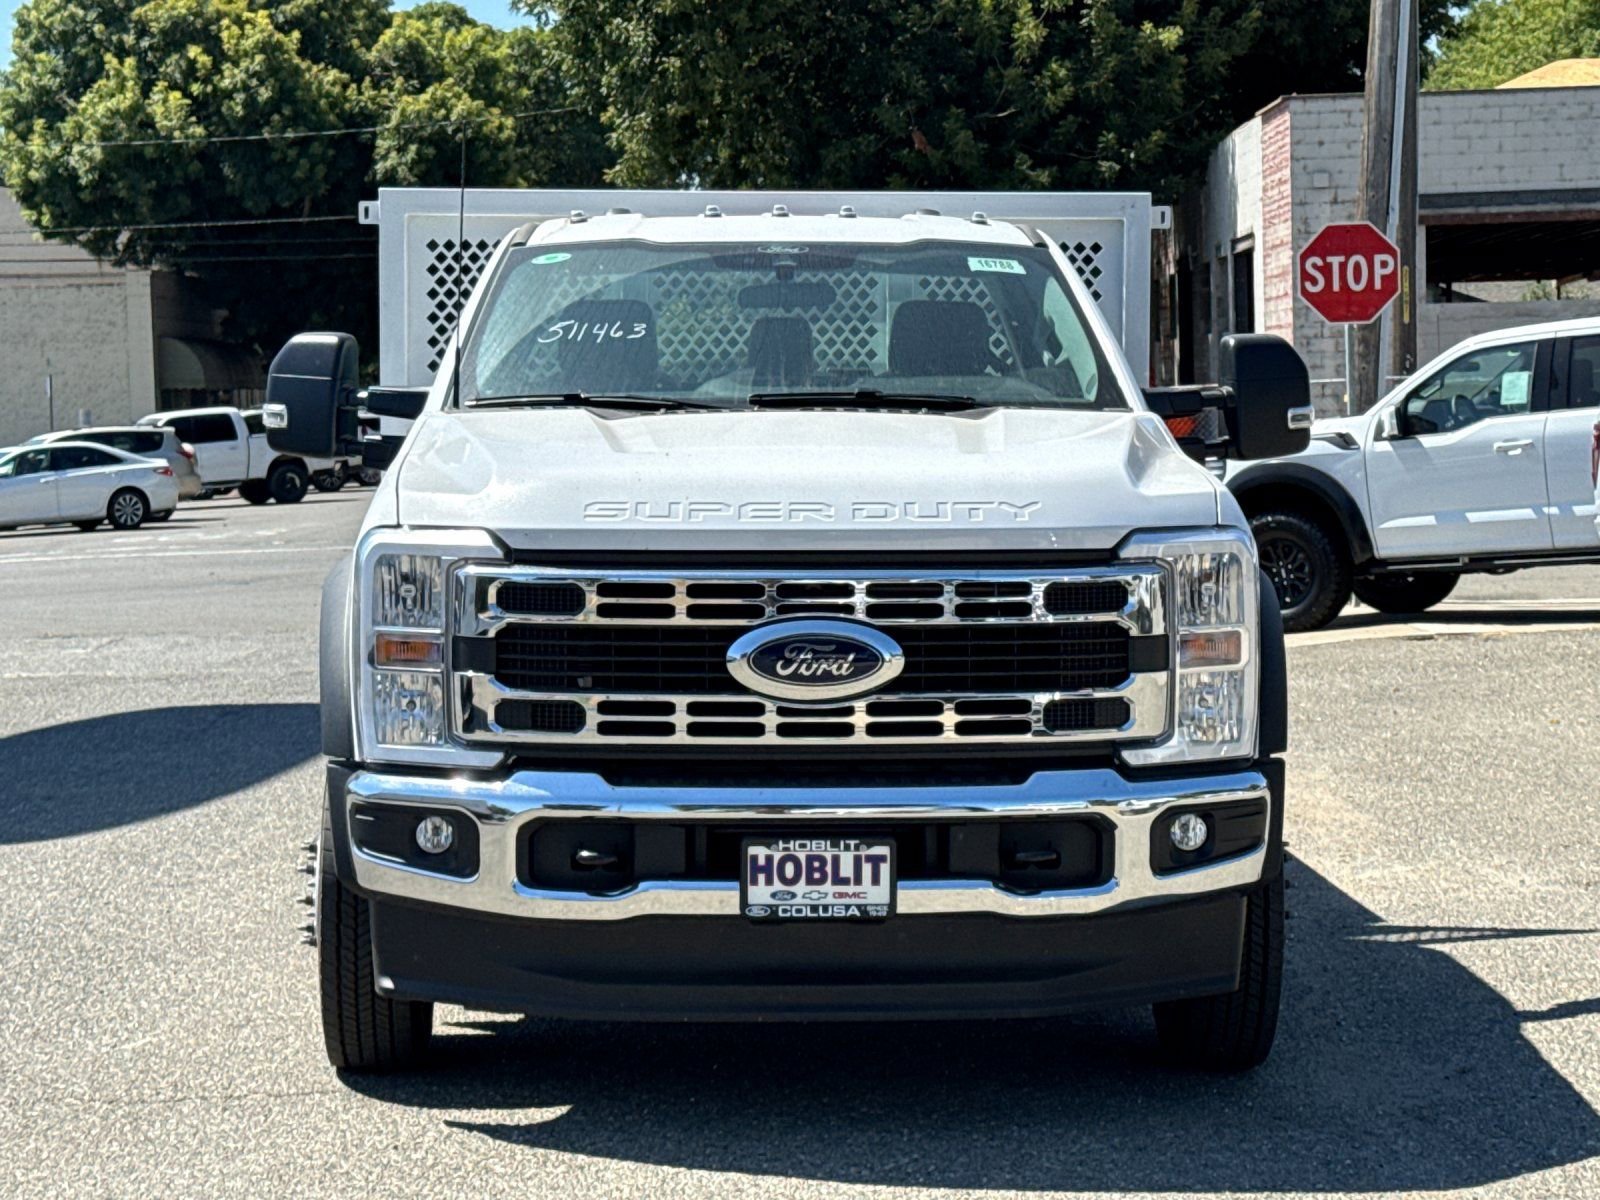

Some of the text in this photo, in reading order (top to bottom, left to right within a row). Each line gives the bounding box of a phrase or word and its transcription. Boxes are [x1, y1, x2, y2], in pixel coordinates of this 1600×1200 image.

[1304, 253, 1395, 293] STOP
[538, 319, 647, 343] 511463
[583, 500, 1042, 522] SUPER DUTY
[775, 642, 855, 677] Ford
[778, 840, 860, 851] HOBLIT
[749, 853, 888, 887] HOBLIT
[832, 891, 868, 899] GMC
[778, 905, 861, 917] COLUSA
